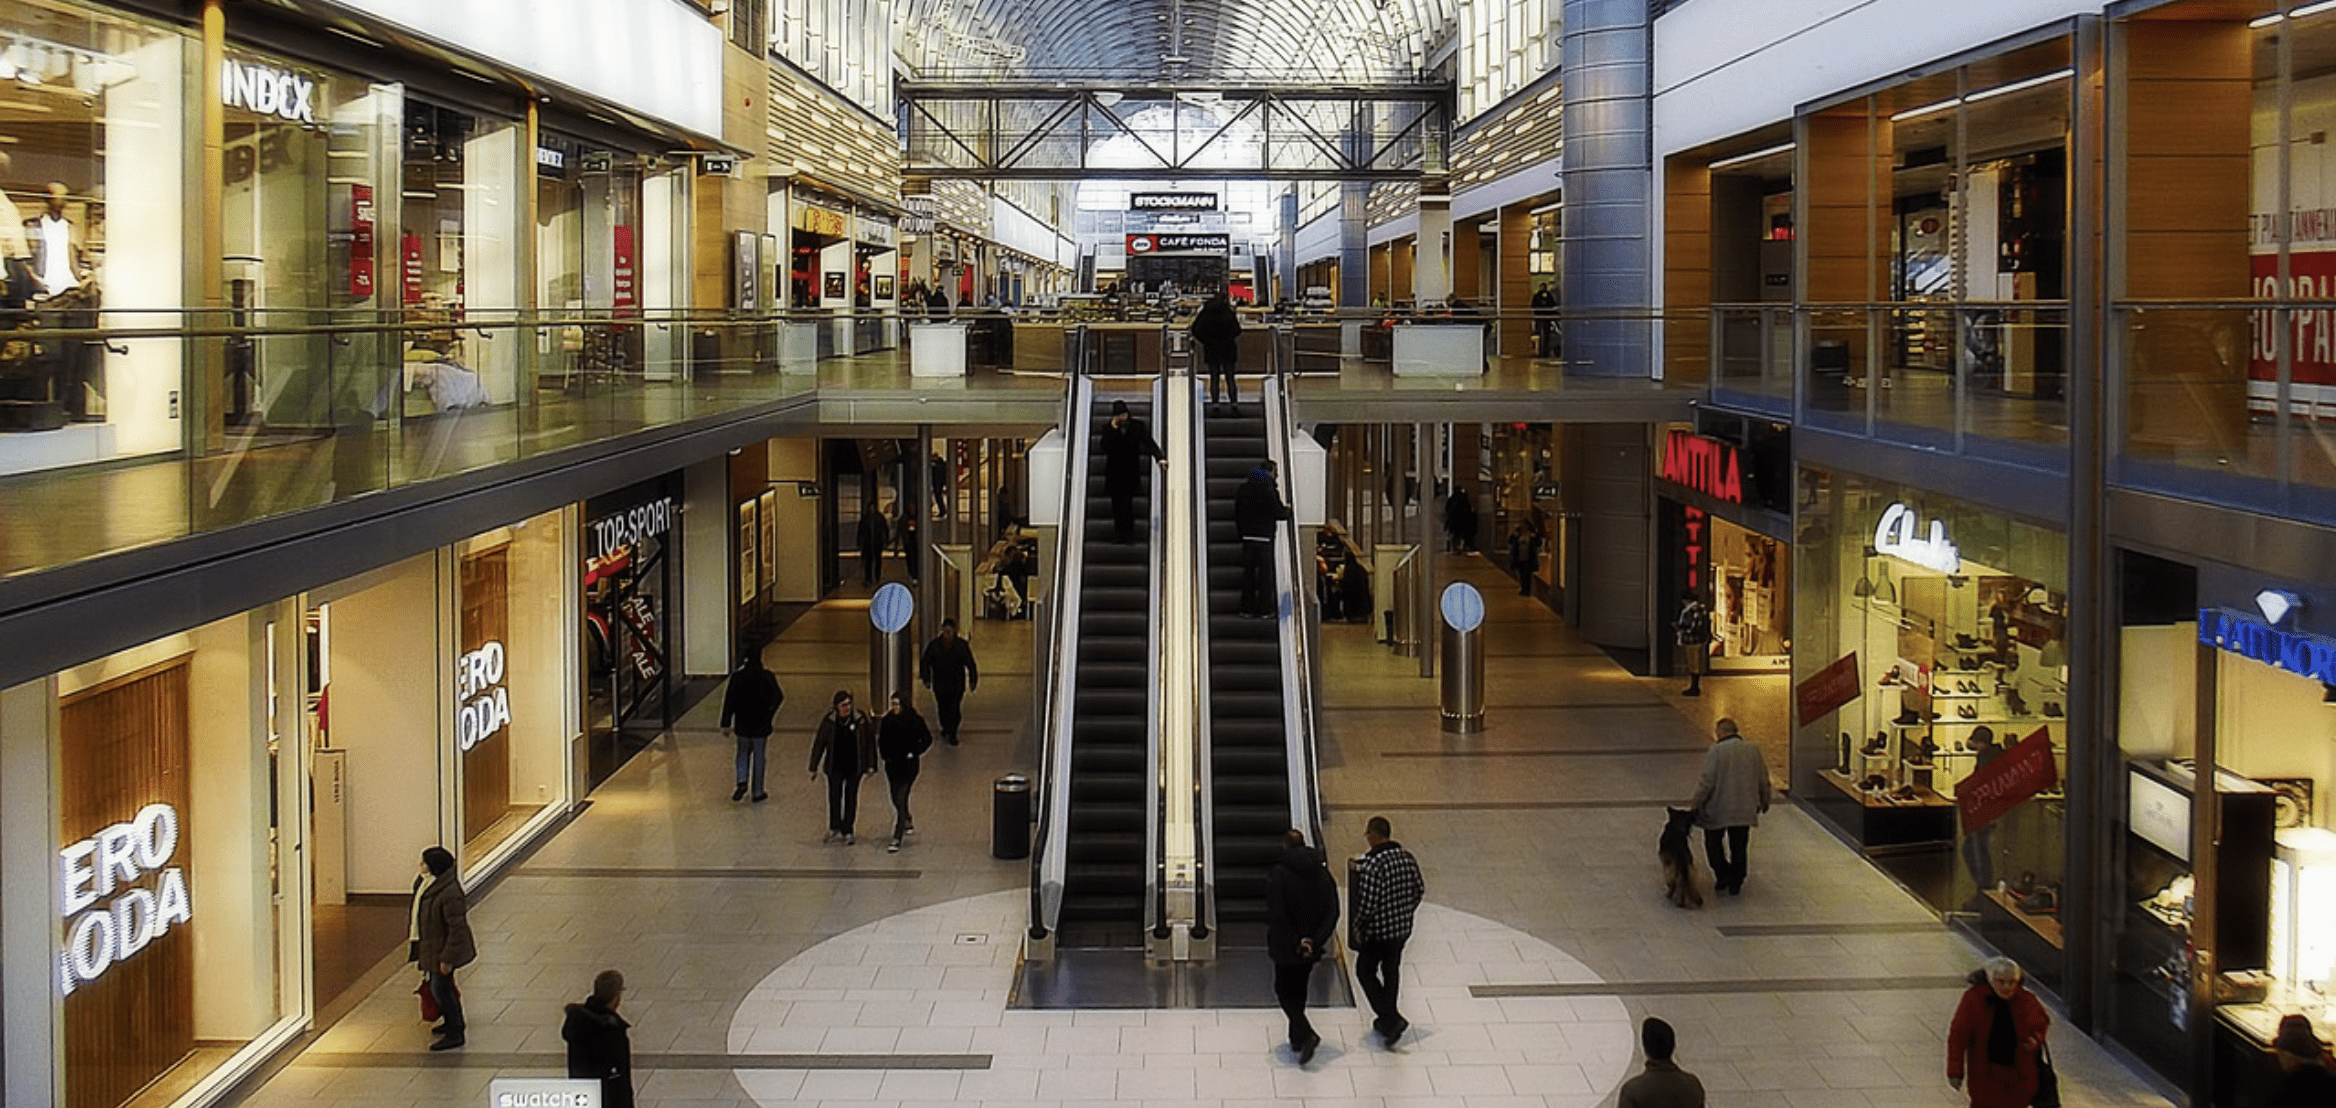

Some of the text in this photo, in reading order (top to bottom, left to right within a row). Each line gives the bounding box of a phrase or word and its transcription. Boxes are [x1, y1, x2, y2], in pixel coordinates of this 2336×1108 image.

[222, 58, 314, 123] INDEX
[1134, 196, 1215, 207] STOCKMANN
[1160, 236, 1187, 246] CAFÉ
[1190, 236, 1227, 246] FONDA
[1663, 430, 1742, 504] ANTTILA
[595, 496, 672, 554] TOP-SPORT
[498, 1091, 574, 1108] swatch
